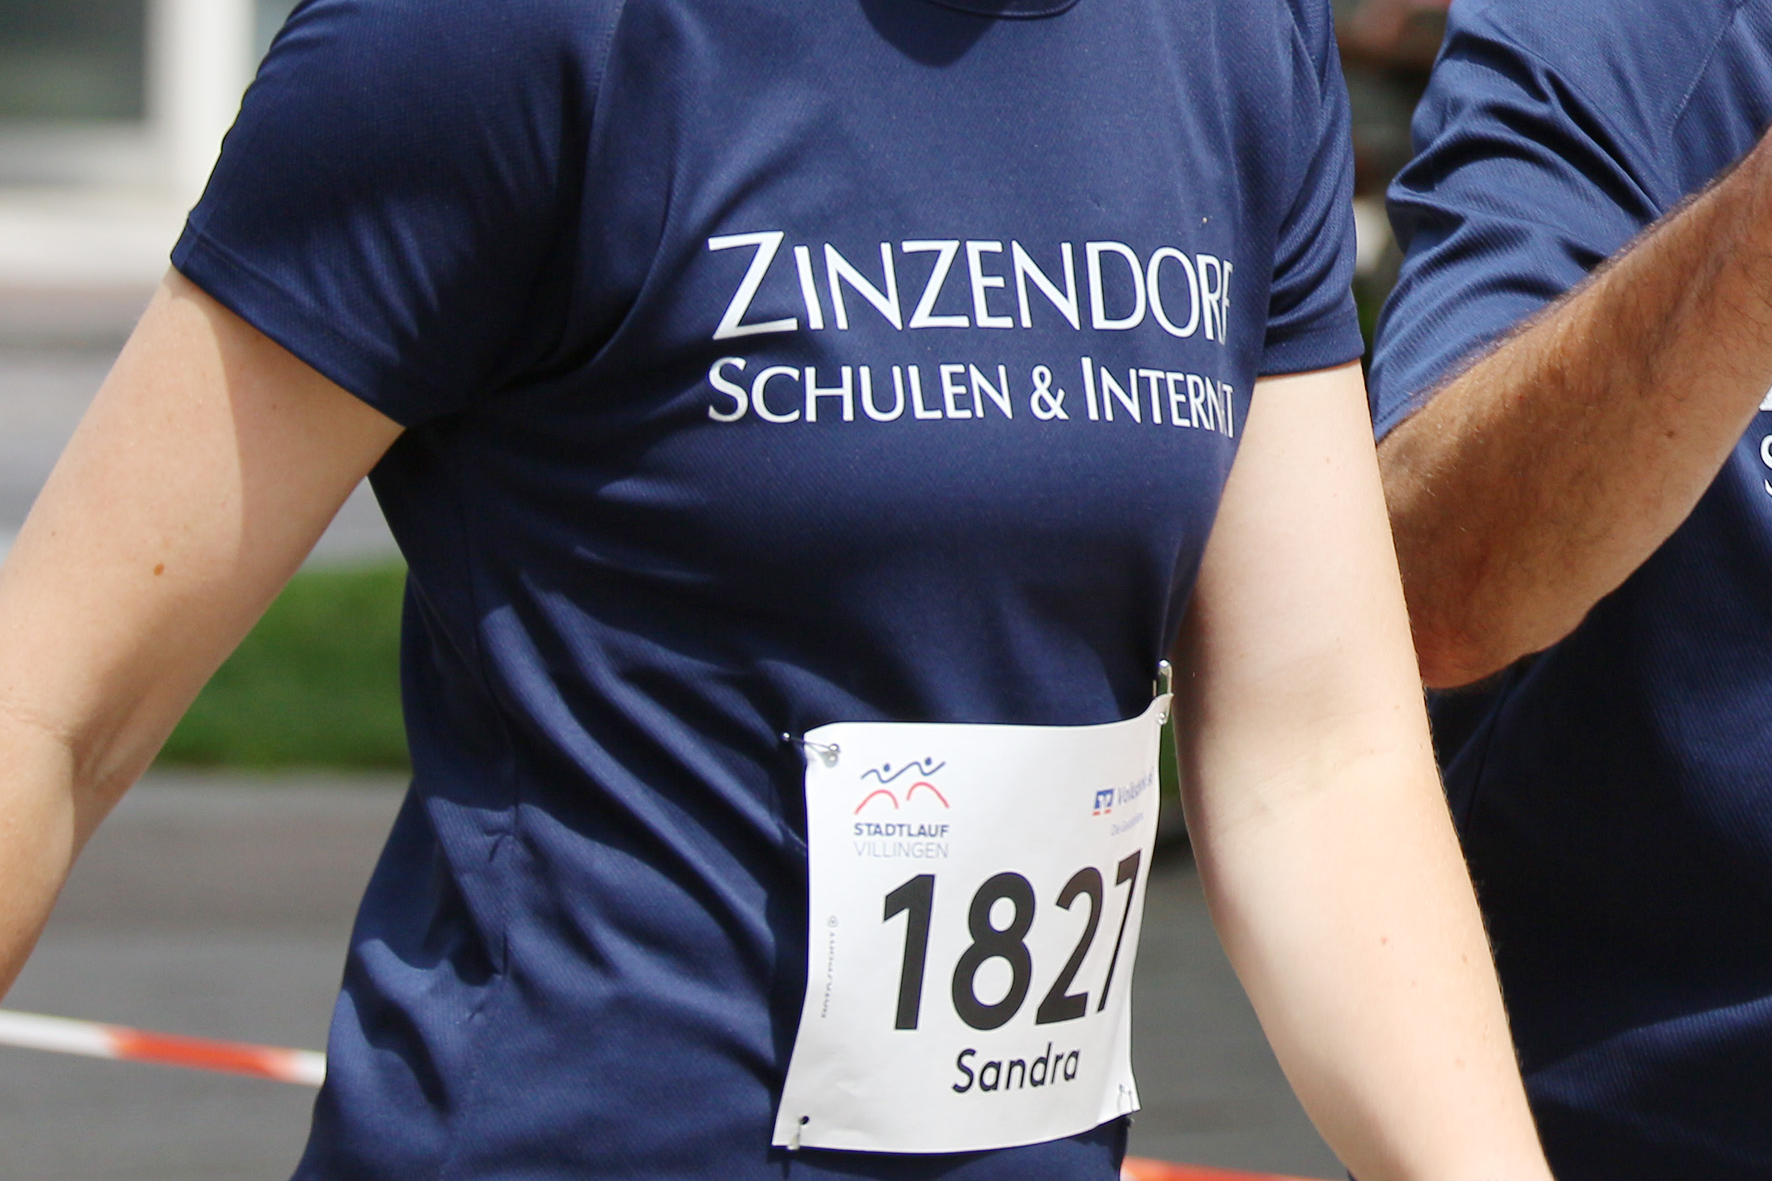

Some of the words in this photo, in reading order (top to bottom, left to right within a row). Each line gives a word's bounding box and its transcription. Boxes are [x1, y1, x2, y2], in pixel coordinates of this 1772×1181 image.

[708, 231, 1234, 345] ZINZENDORF
[708, 357, 1014, 423] SCHULEN
[1030, 365, 1069, 421] &
[1081, 357, 1235, 438] INTERNT
[853, 822, 950, 839] STADTLAUF
[853, 840, 950, 860] VILLINGEN
[882, 849, 1143, 1031] 1827
[952, 1042, 1081, 1094] Sandra
